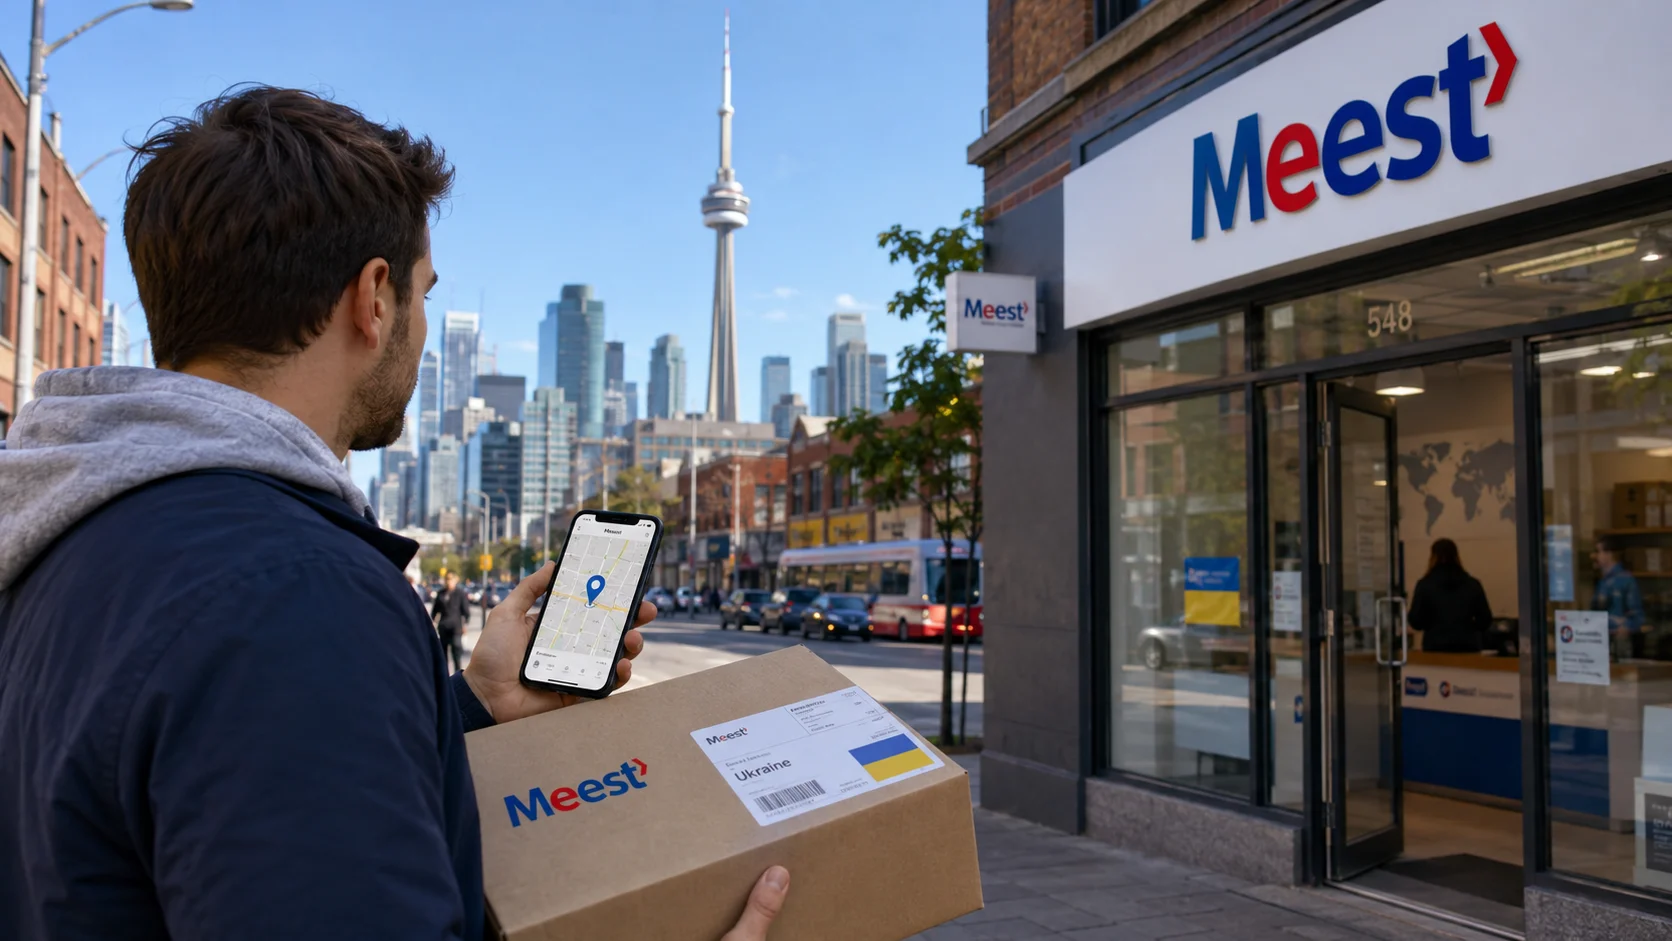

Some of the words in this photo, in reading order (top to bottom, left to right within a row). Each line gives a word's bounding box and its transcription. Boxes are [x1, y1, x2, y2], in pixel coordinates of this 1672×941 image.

[1191, 33, 1491, 242] Meest
[964, 298, 1024, 321] Meest
[1367, 300, 1413, 339] 548
[706, 728, 748, 746] Meest
[734, 758, 792, 782] Ukraine
[503, 762, 647, 828] Meest
